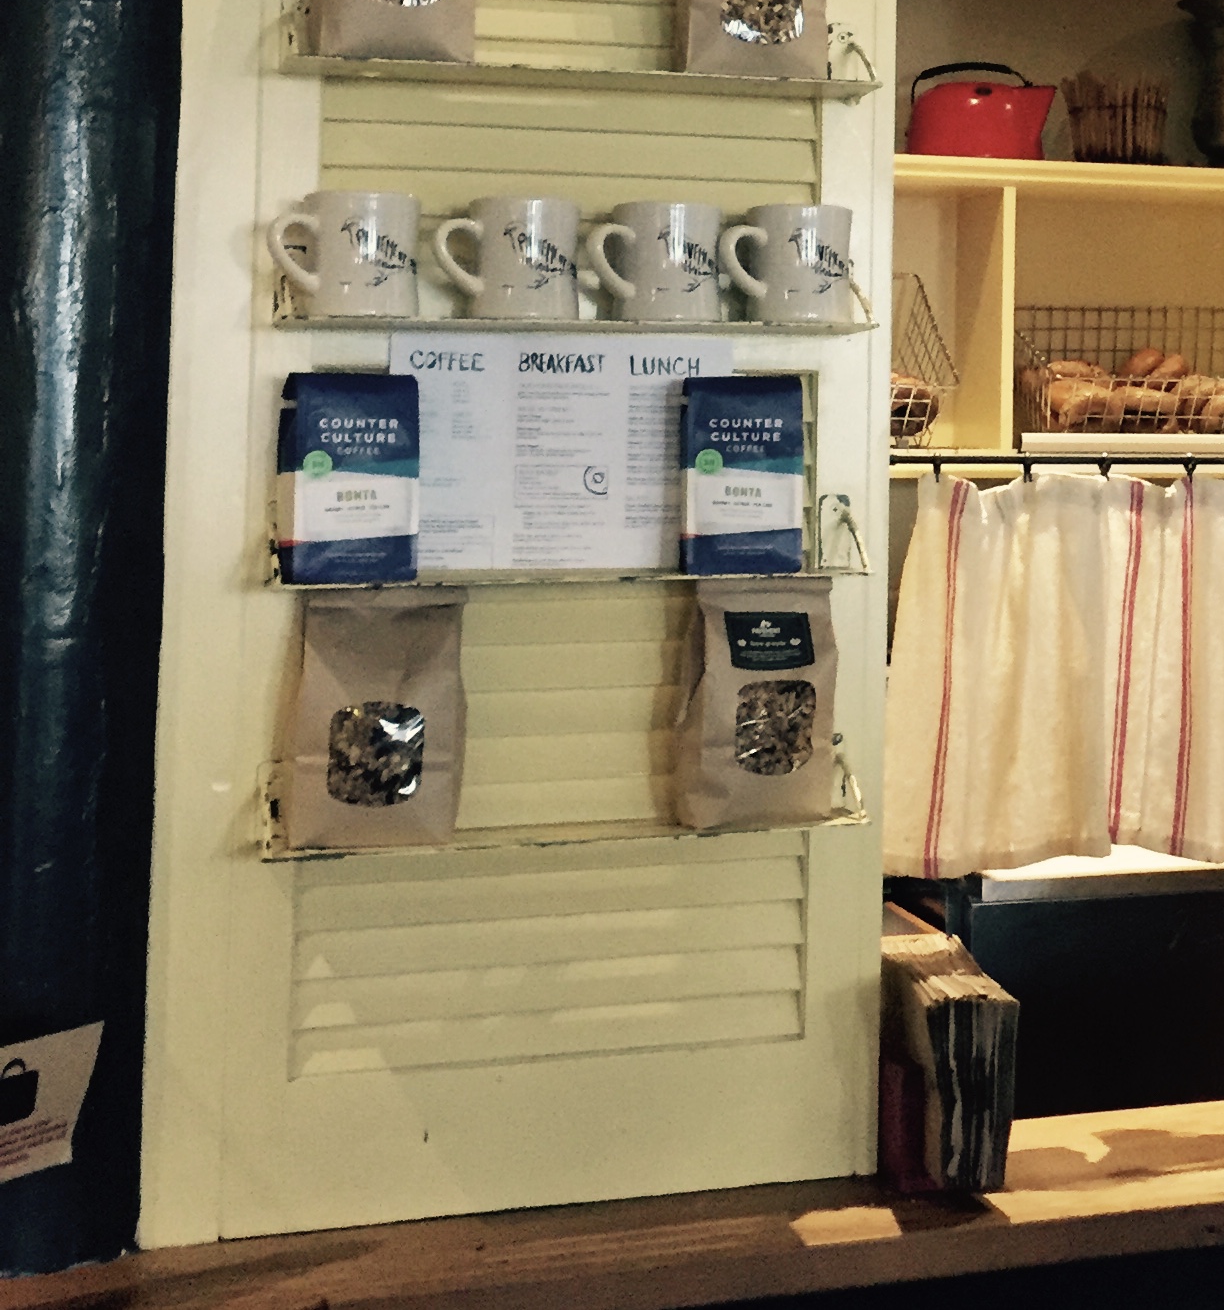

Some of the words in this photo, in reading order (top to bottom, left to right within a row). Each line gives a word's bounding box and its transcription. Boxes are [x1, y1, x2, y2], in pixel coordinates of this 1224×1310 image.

[410, 350, 485, 372] COFFEE
[518, 353, 606, 374] BREAKFAST
[630, 355, 700, 377] LUNCH
[319, 418, 398, 429] COUNTER
[709, 418, 784, 428] COUNTER
[320, 432, 396, 443] CULTURE
[710, 432, 781, 442] CULTURE
